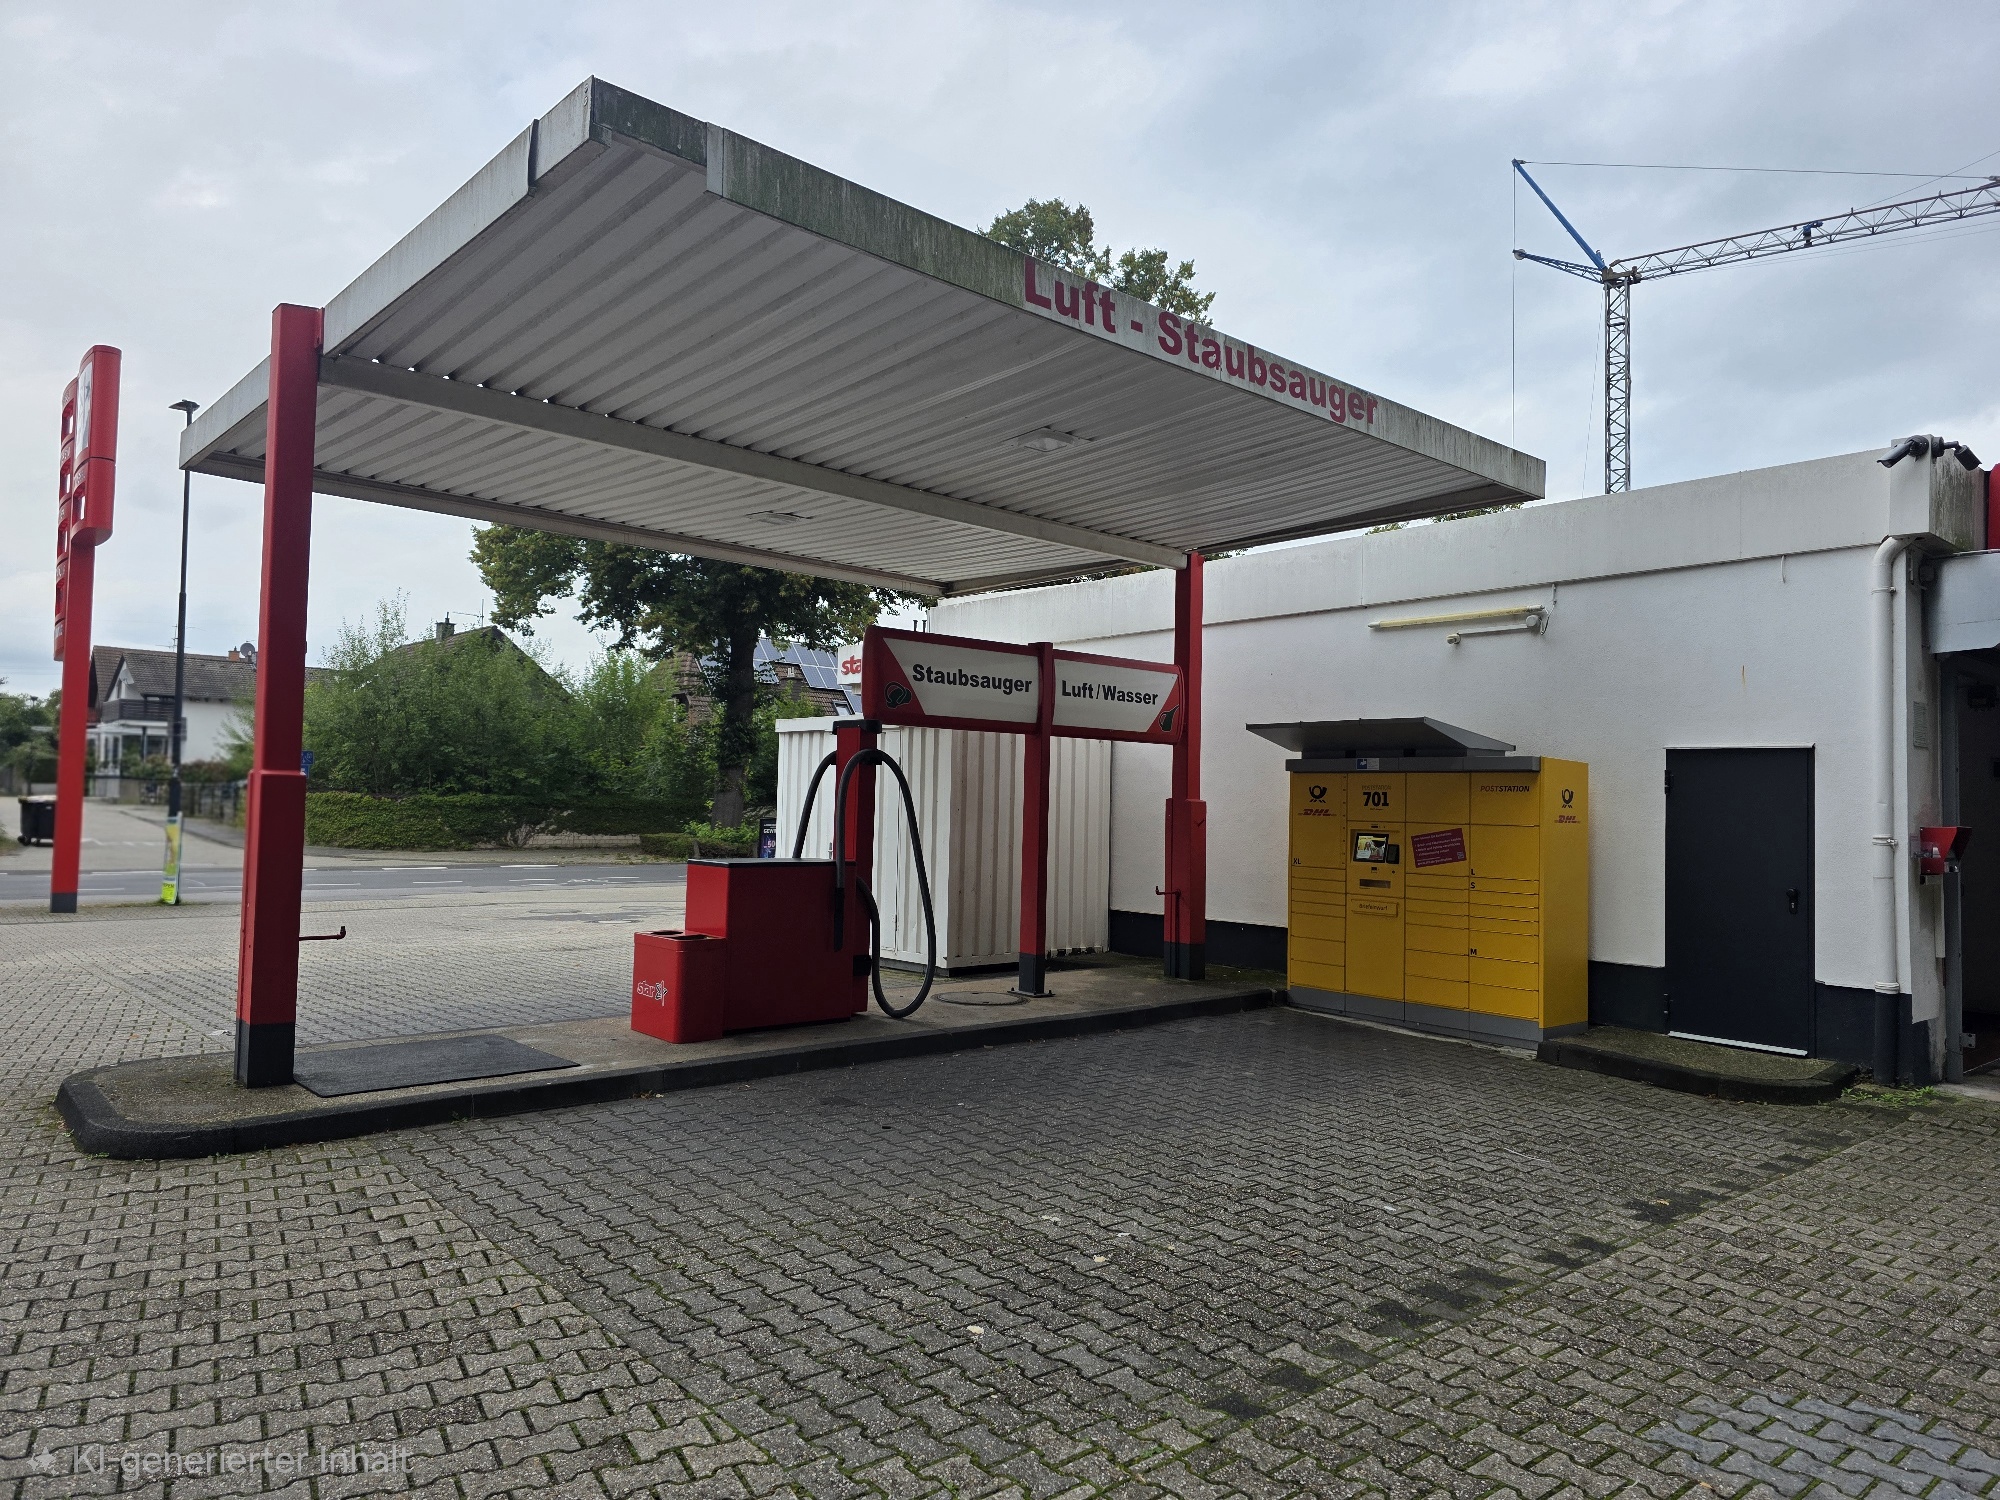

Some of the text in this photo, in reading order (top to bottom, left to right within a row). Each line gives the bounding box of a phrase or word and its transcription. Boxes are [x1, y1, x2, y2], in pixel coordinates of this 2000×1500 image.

[1024, 256, 1379, 424] Luft - Staubsauger
[841, 655, 862, 675] sta
[912, 663, 1033, 695] Staubsauger
[1480, 785, 1530, 793] POSTSTATION
[1362, 791, 1390, 807] 701
[1300, 808, 1333, 817] DHL
[1470, 948, 1478, 956] M
[636, 980, 656, 998] star
